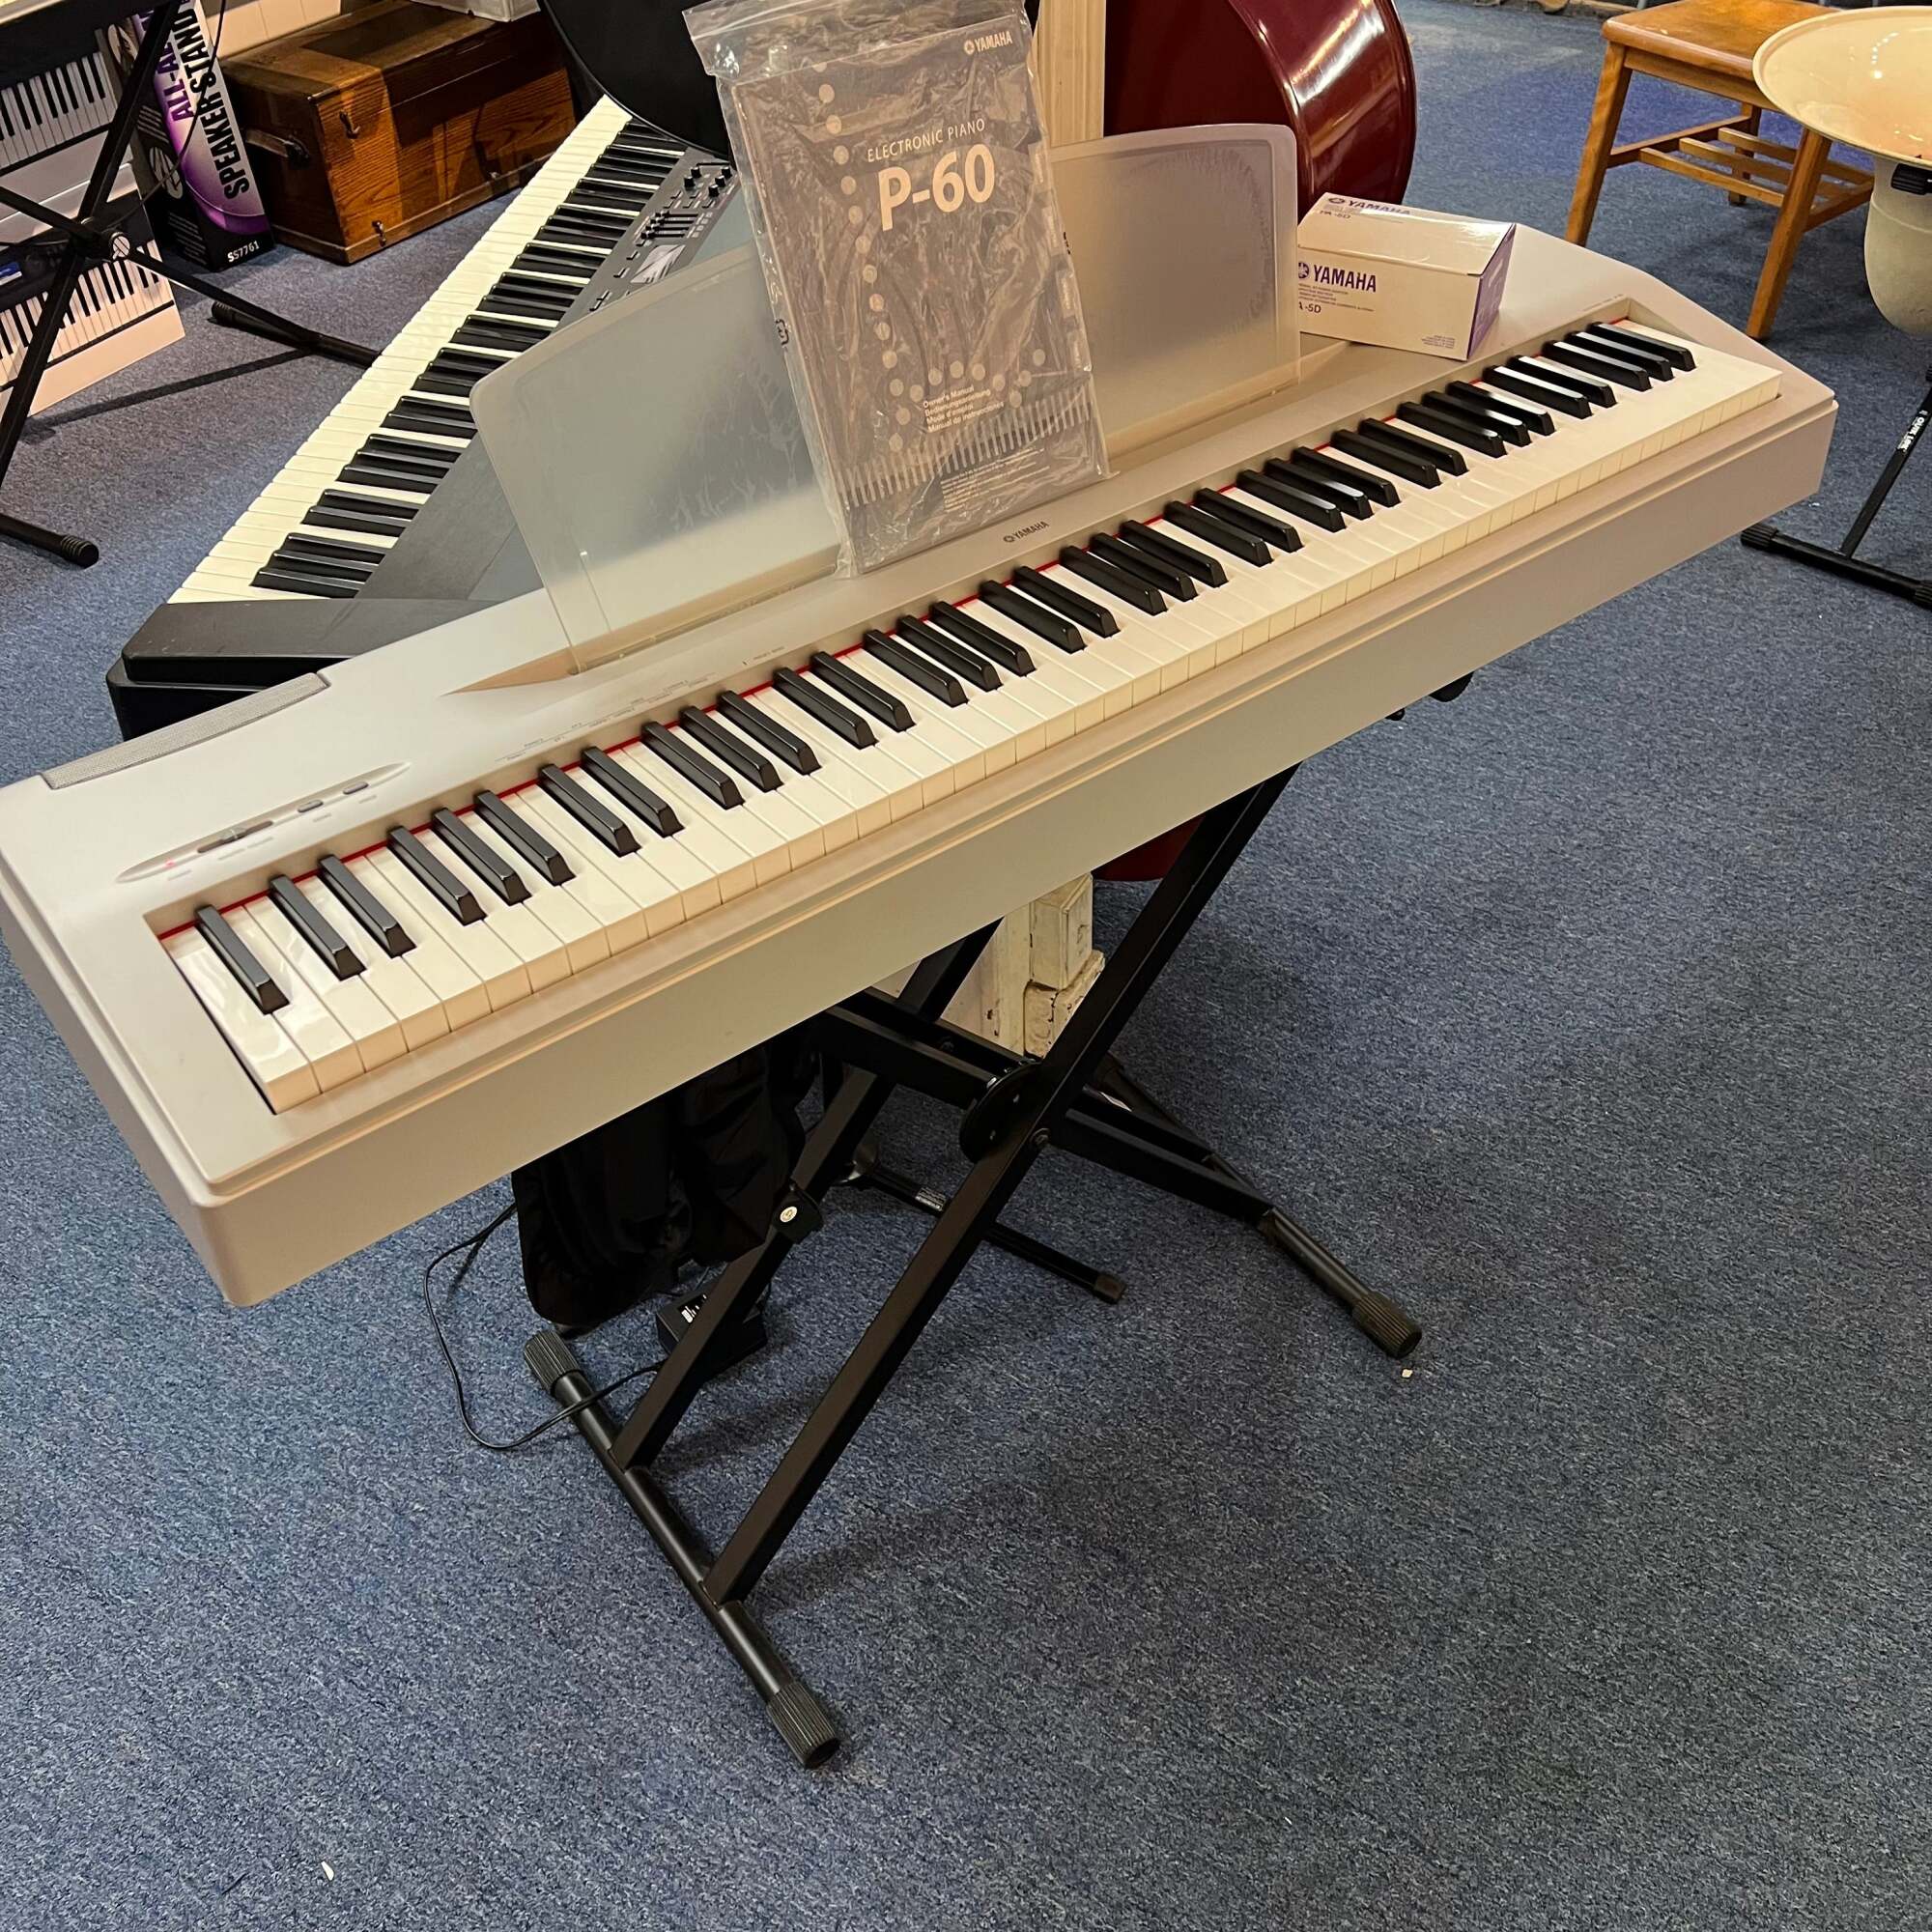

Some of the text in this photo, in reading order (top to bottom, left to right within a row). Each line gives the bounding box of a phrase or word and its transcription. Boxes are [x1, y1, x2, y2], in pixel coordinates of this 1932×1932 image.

[975, 31, 1012, 52] YAMAHA
[172, 8, 249, 200] SPEAKER STAND
[867, 118, 985, 162] ELECTRONIC PIANO
[878, 143, 995, 232] P-60
[1349, 200, 1410, 214] YAMAHA
[227, 241, 260, 262] SS7761
[1314, 264, 1377, 293] YAMAHA
[1012, 521, 1049, 539] YAMAHA
